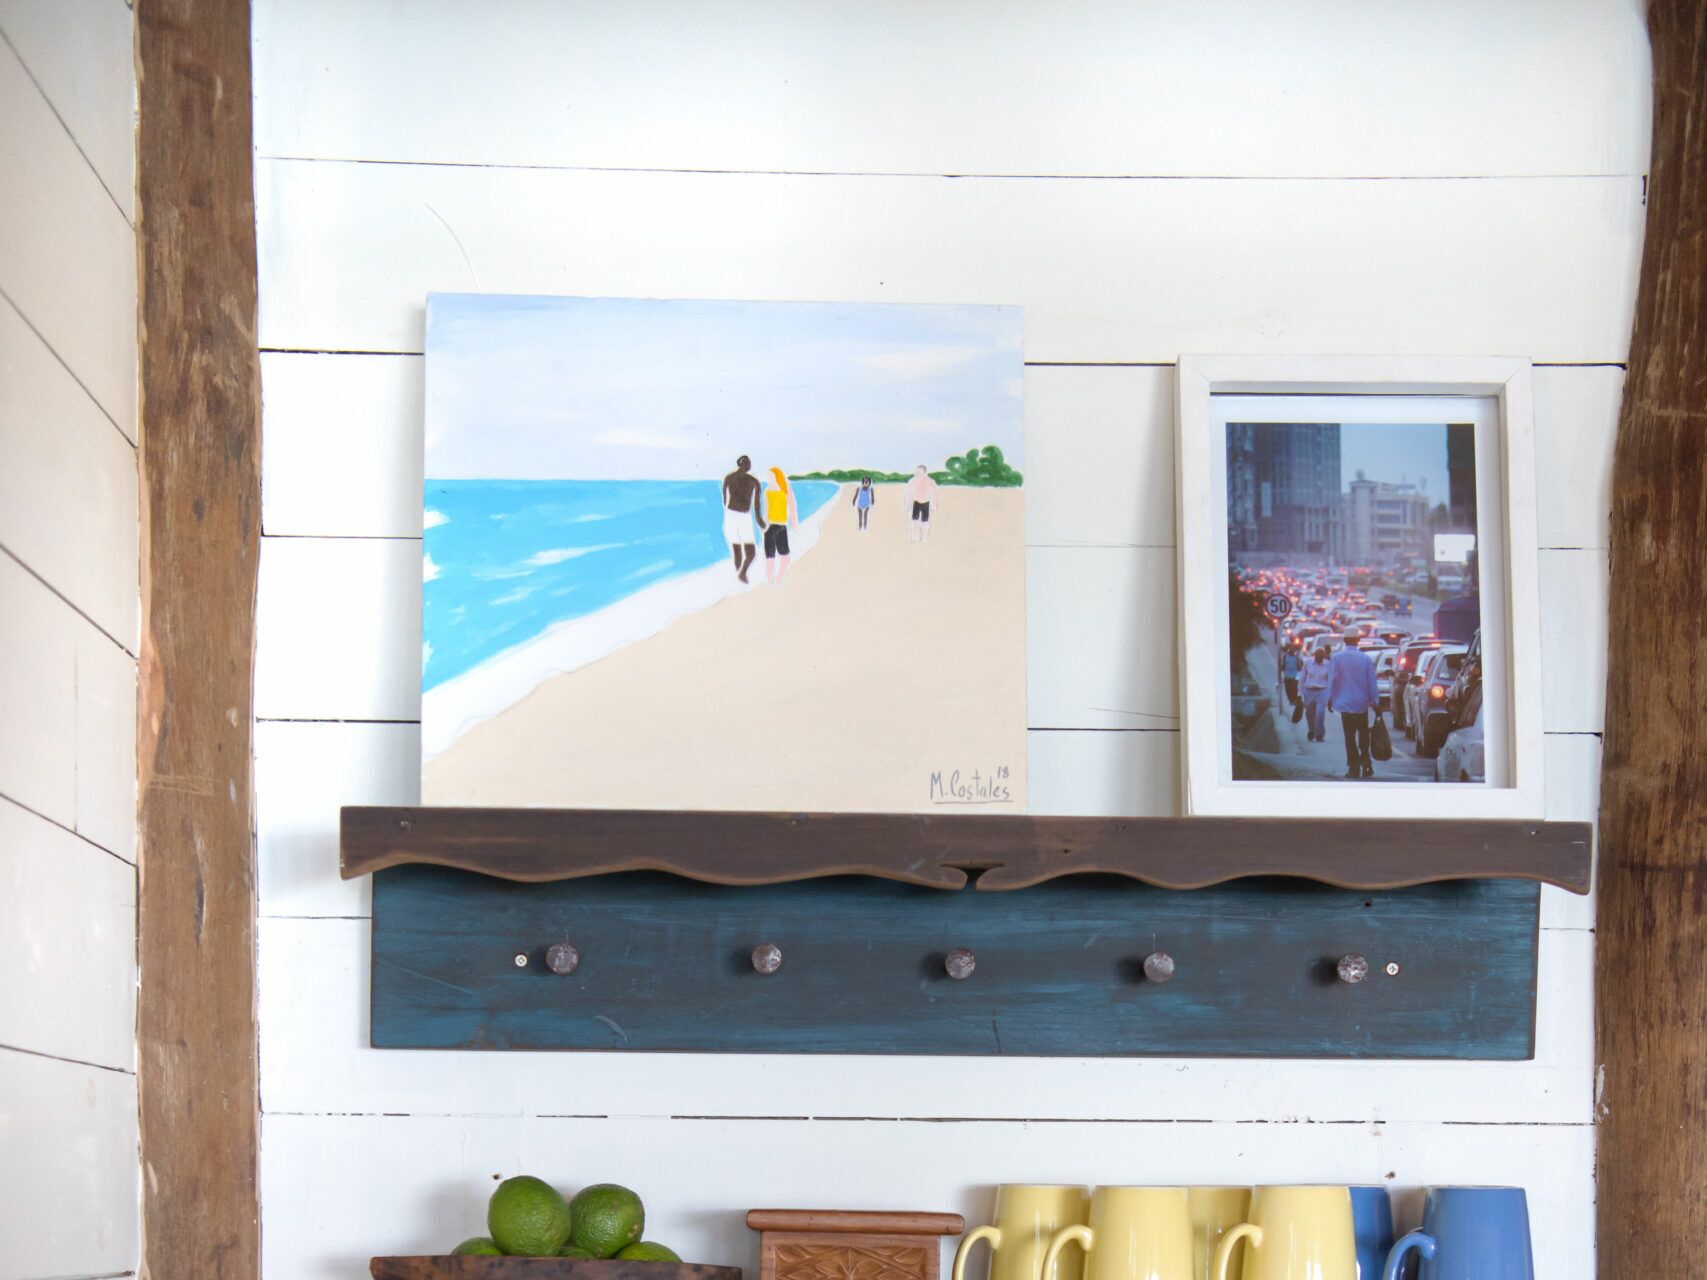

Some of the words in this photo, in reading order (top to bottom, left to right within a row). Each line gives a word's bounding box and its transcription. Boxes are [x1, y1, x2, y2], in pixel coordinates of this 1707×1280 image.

[1271, 599, 1288, 614] 50
[998, 766, 1010, 779] 18
[930, 771, 948, 800] M.
[950, 768, 1010, 801] Costales
